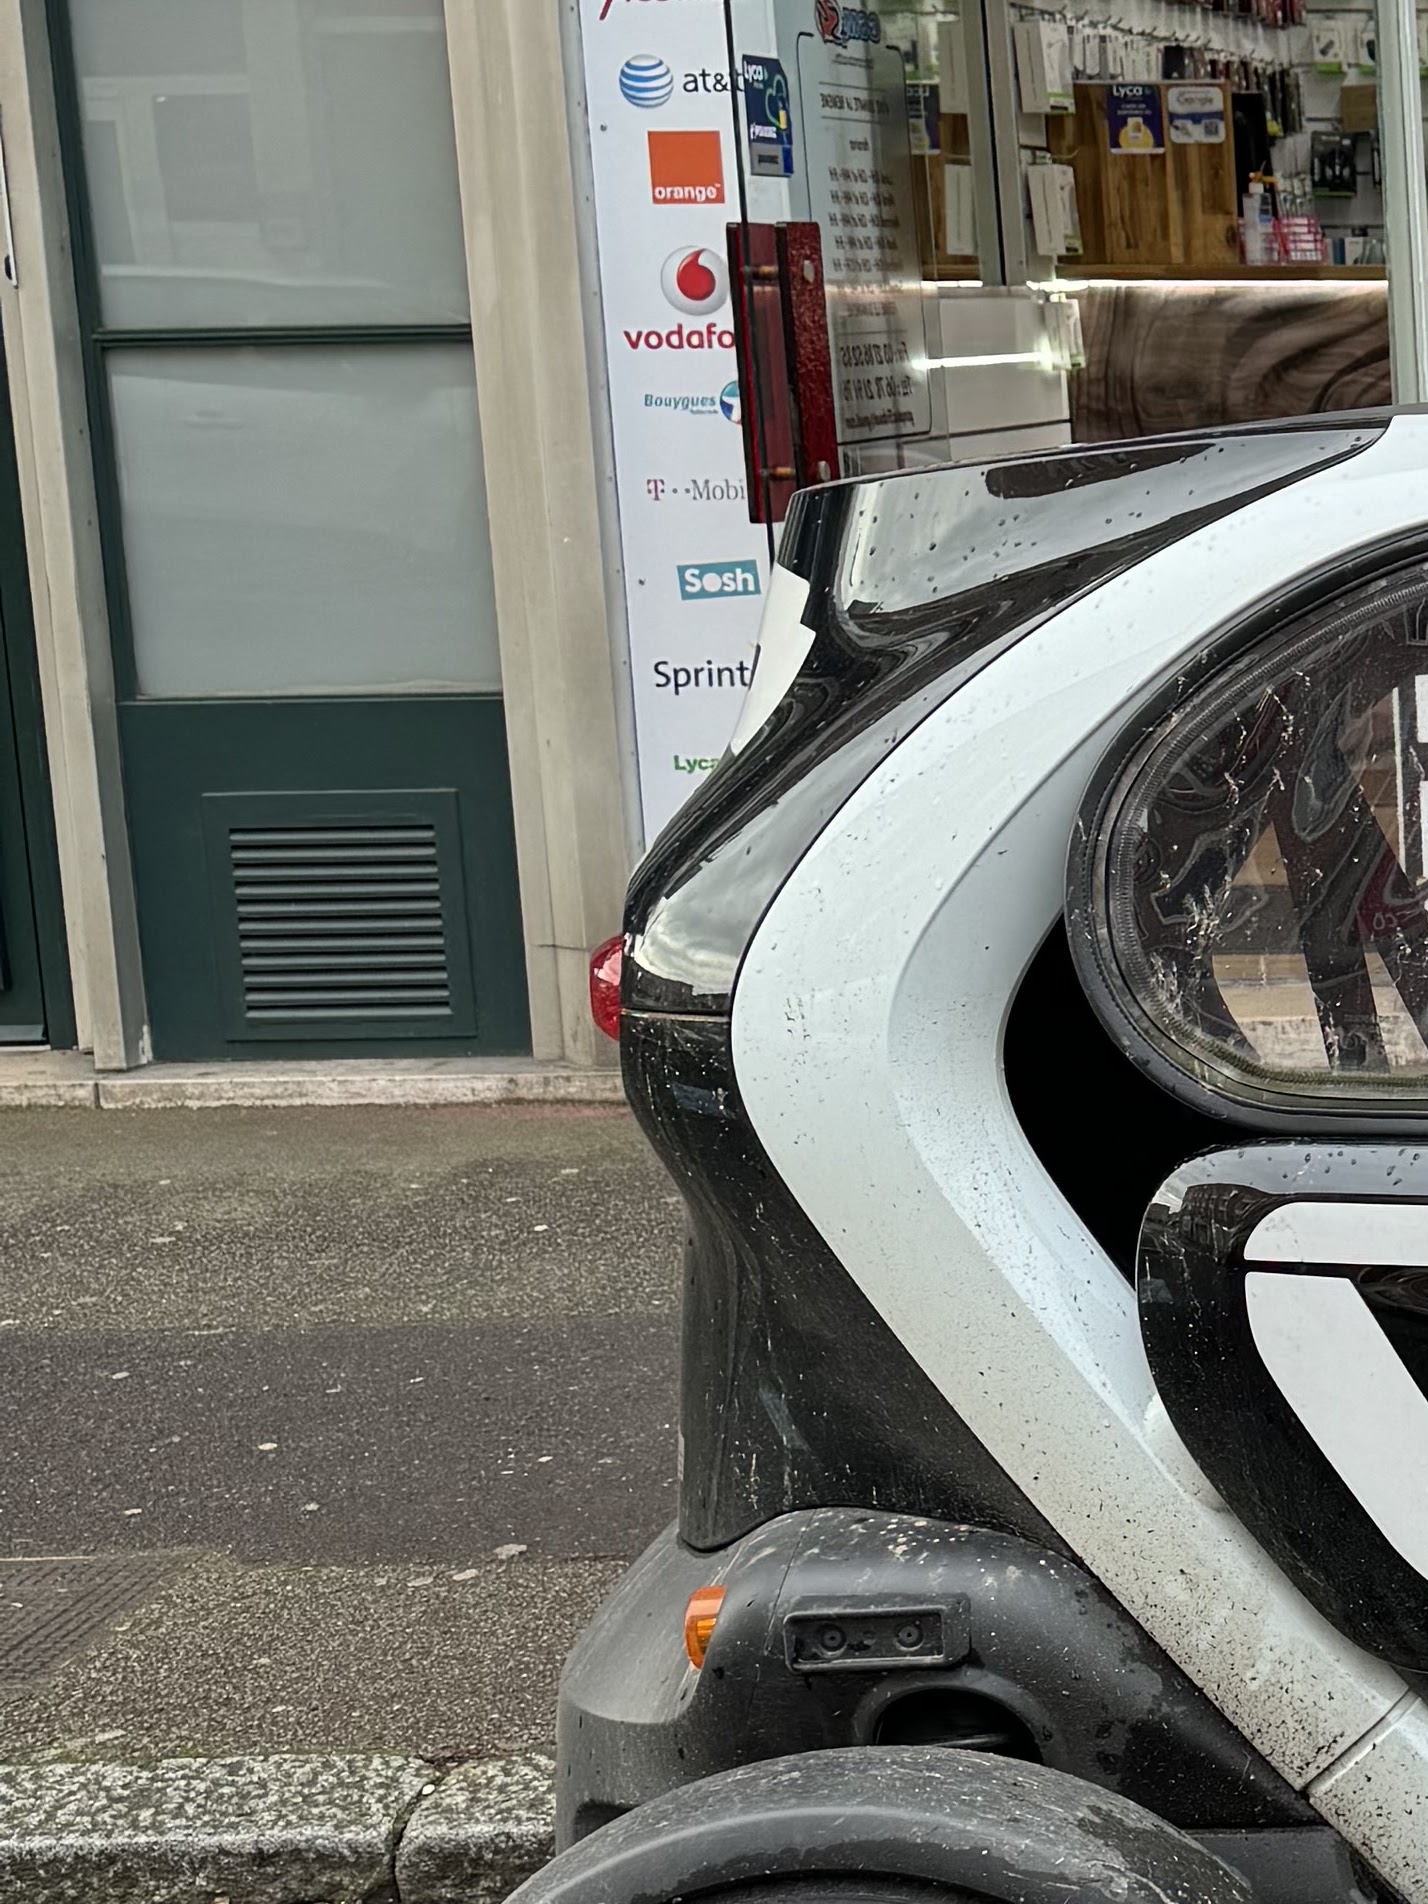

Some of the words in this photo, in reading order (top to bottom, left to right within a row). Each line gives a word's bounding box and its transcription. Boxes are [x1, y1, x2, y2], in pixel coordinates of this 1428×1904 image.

[1112, 85, 1143, 98] Lyca
[653, 183, 719, 202] orange
[644, 394, 716, 410] Bouygues
[684, 565, 755, 594] Sosh
[653, 660, 750, 696] Sprint
